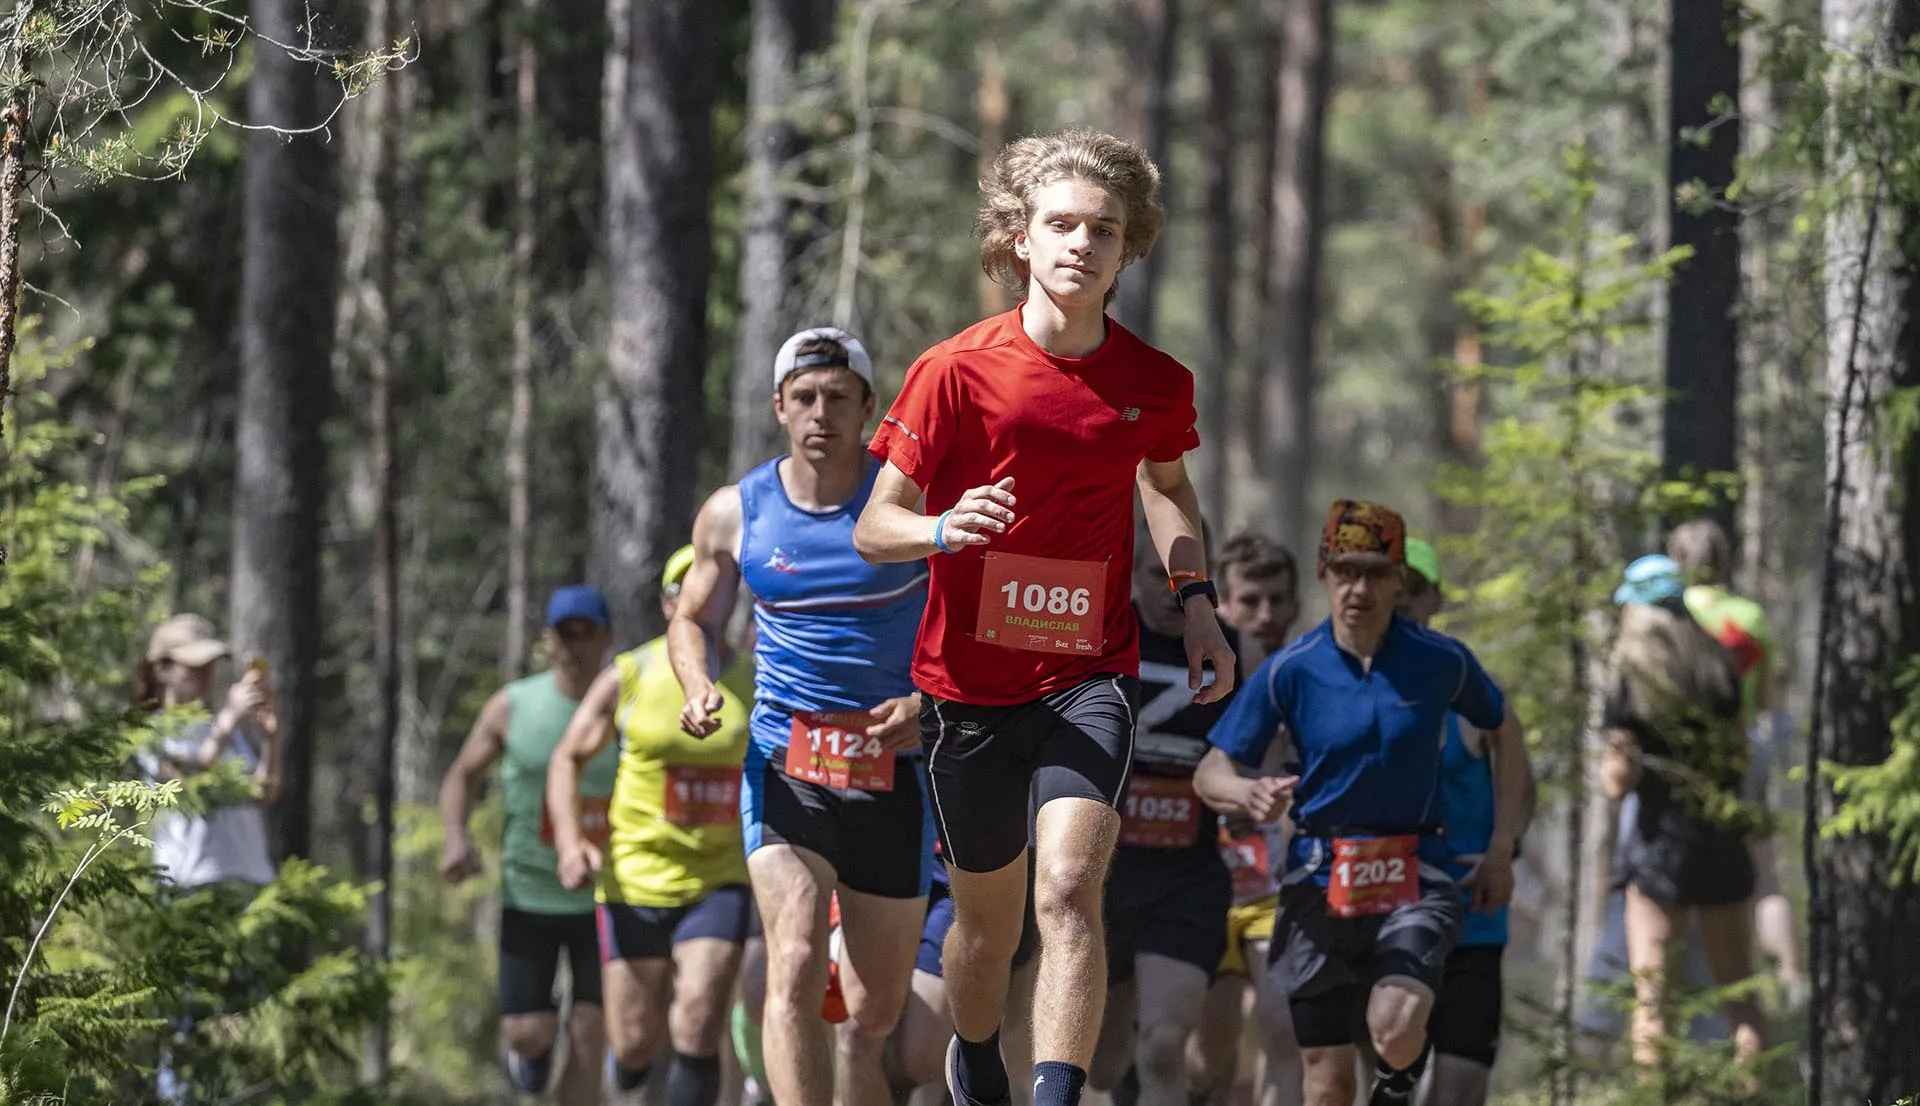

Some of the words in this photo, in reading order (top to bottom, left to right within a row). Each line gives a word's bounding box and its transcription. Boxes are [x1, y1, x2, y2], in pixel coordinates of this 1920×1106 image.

[1001, 580, 1090, 616] 1086
[1005, 615, 1080, 631] ВЛАДИСЛАВ
[806, 727, 882, 759] 1124
[1126, 796, 1191, 821] 1052
[1336, 857, 1405, 887] 1202
